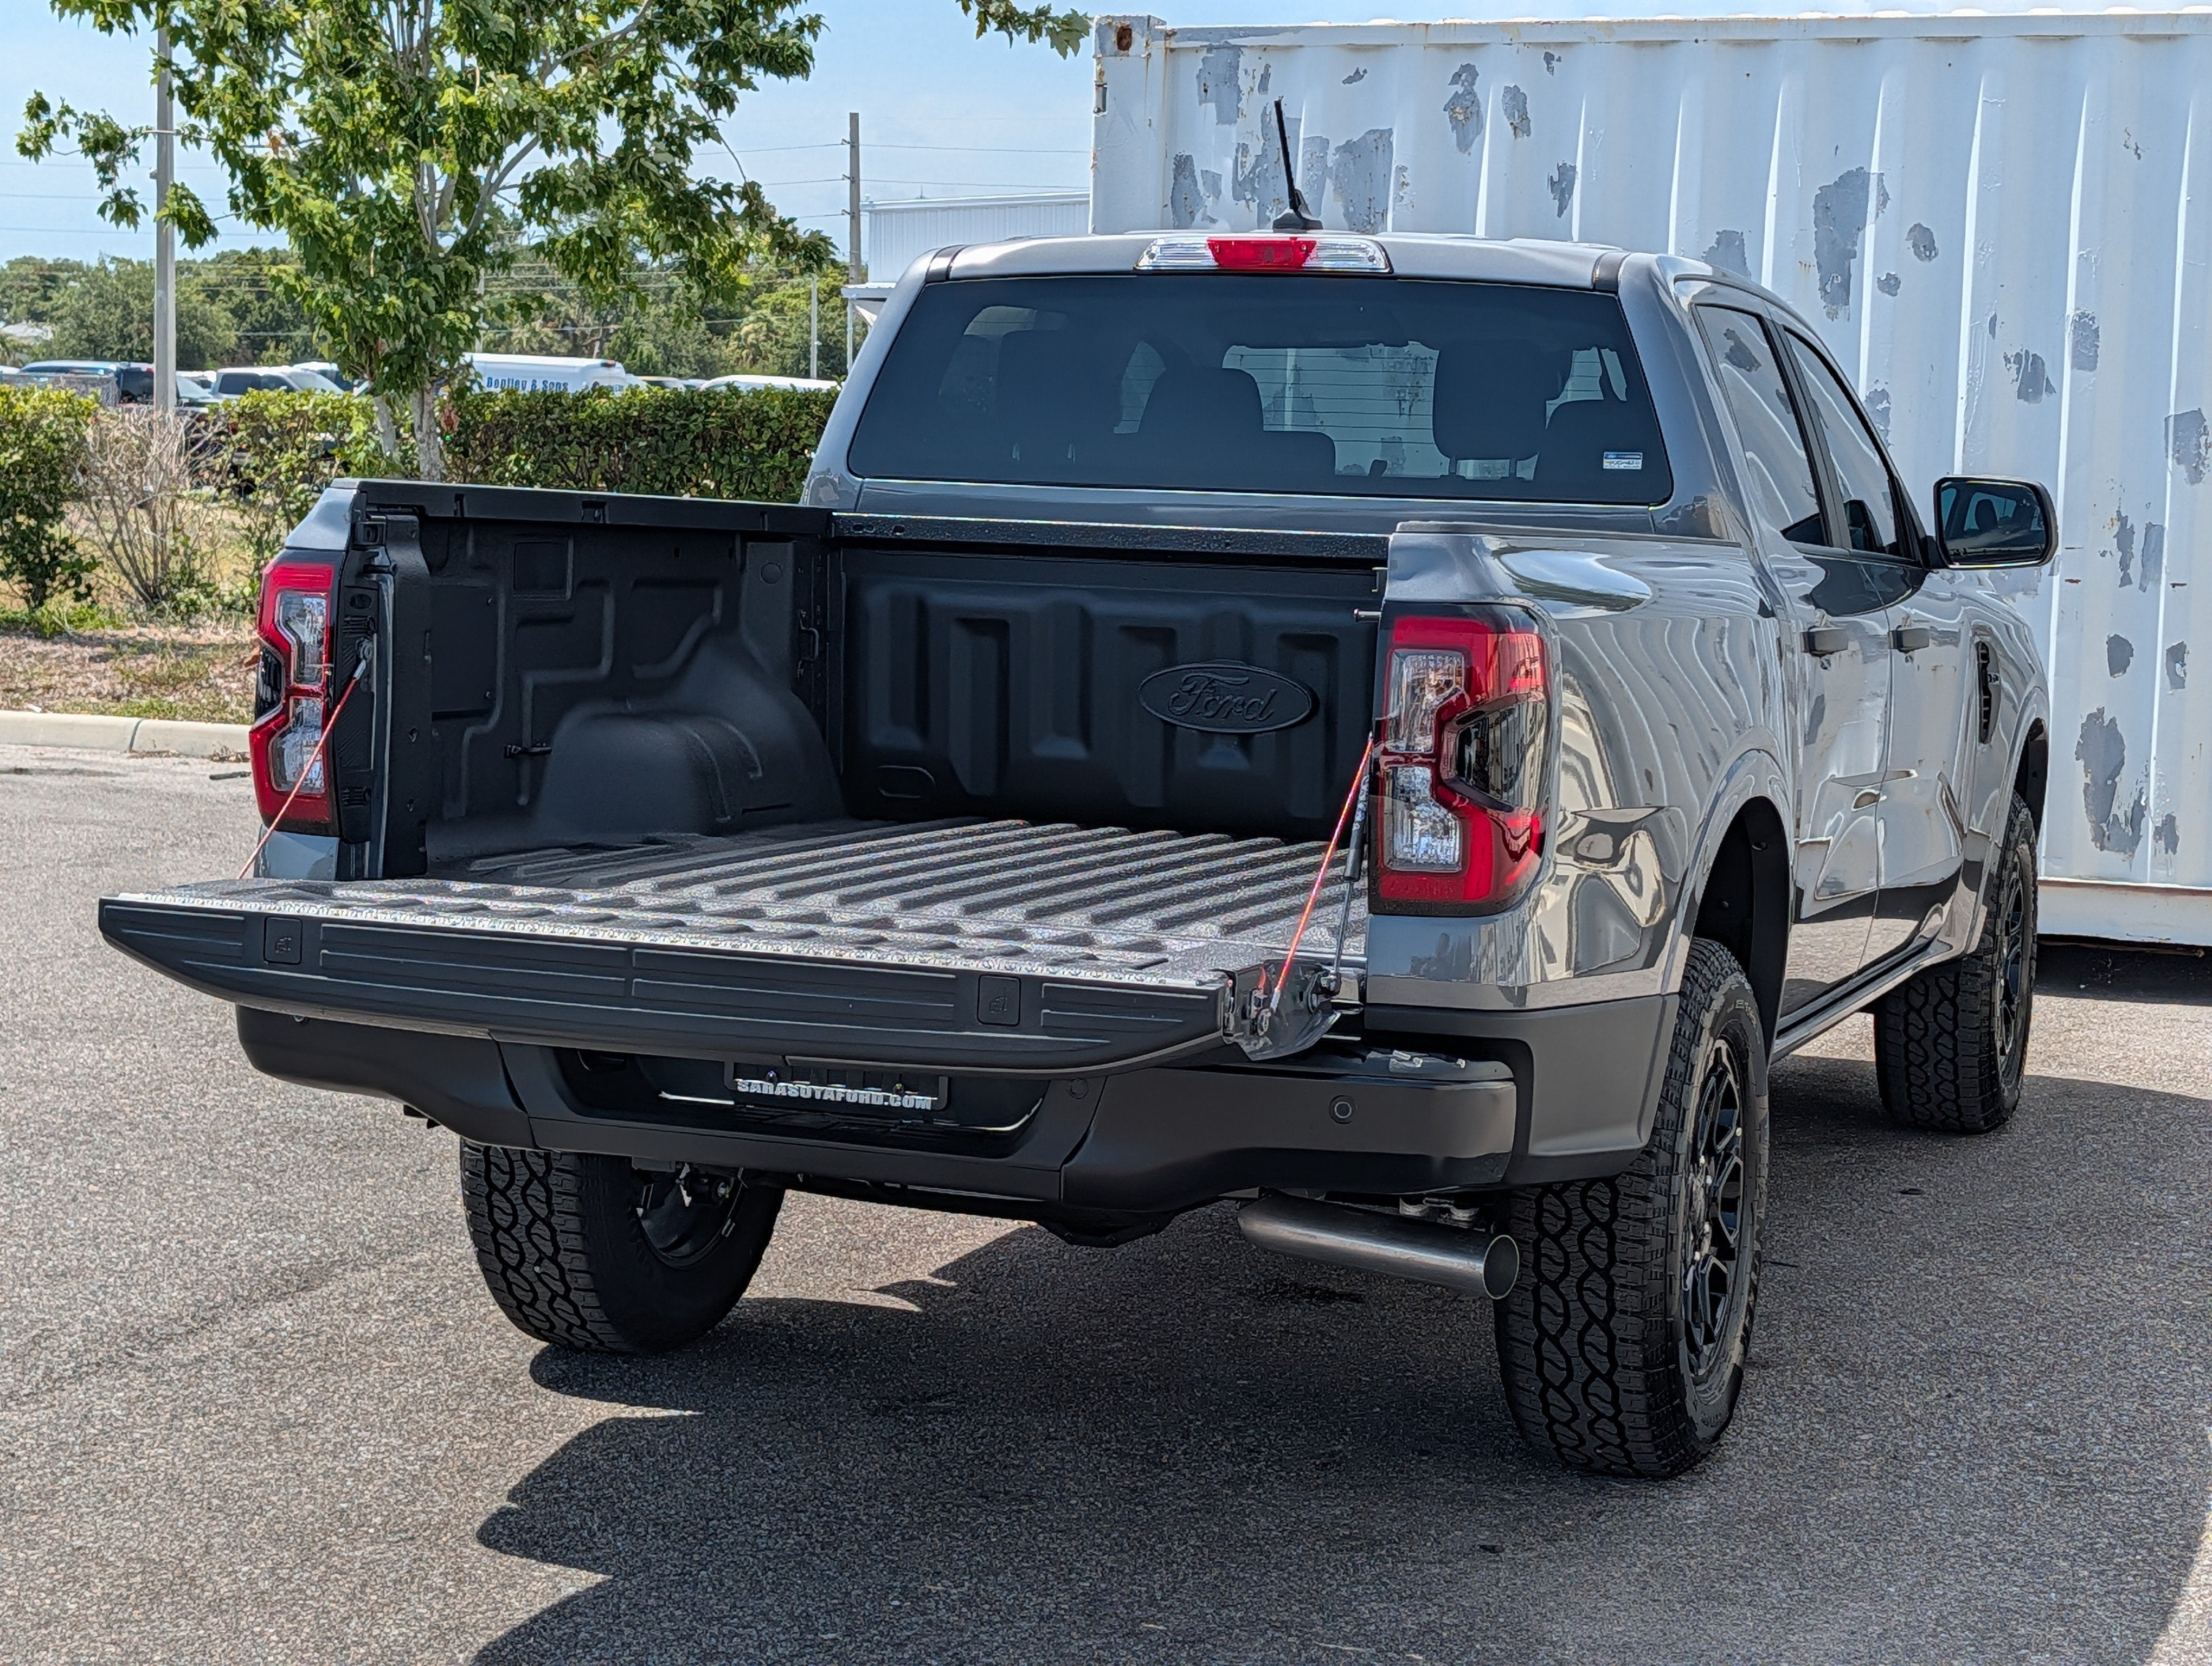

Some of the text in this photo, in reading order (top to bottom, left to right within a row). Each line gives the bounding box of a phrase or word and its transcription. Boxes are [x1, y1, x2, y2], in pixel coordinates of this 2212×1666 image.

[542, 380, 569, 392] Sons
[1168, 671, 1278, 722] Ford
[737, 1079, 932, 1110] SARASOTAFORD.COM
